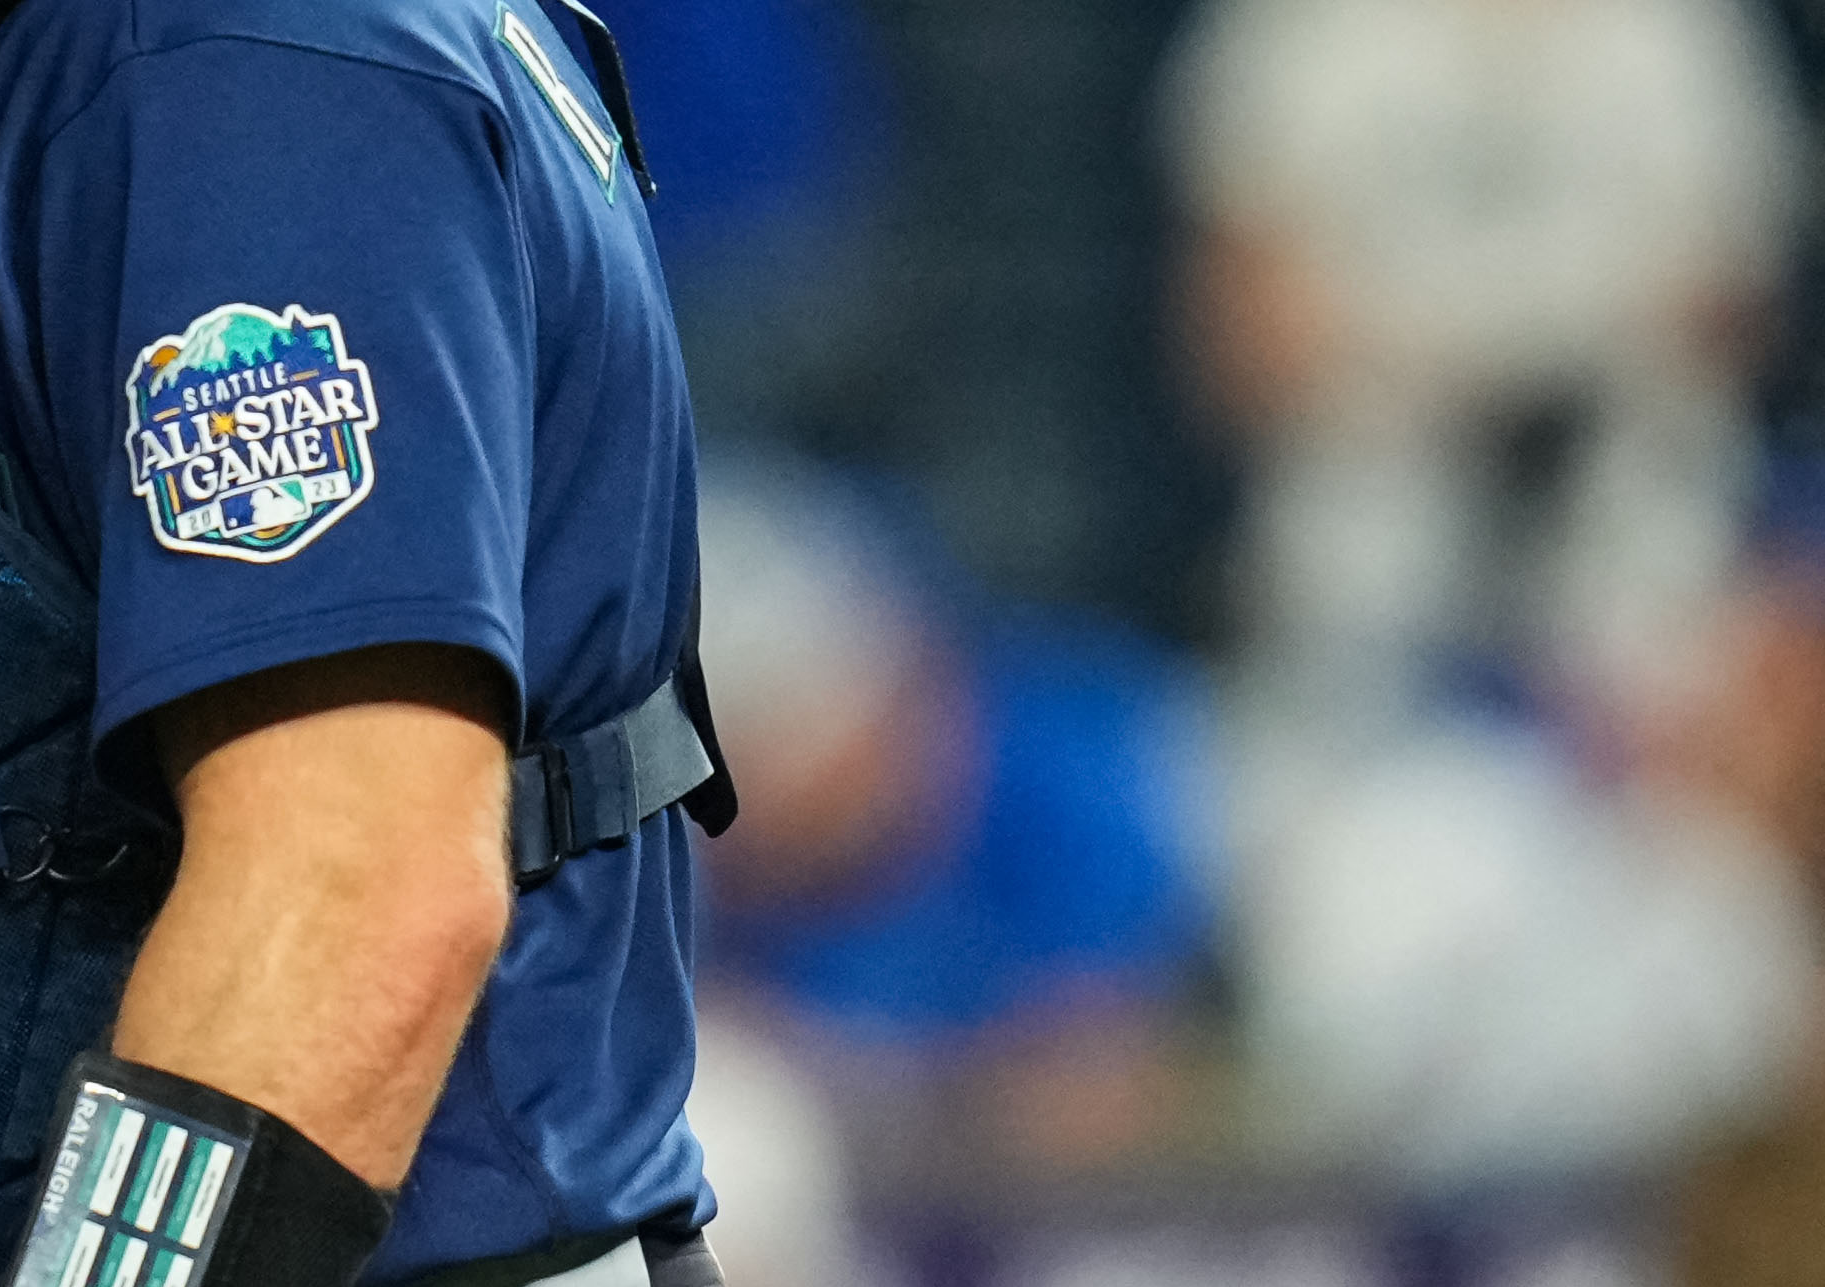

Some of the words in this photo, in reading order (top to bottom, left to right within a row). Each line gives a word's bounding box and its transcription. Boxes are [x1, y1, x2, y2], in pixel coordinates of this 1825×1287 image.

[181, 362, 289, 413] SEATTLE
[138, 412, 230, 481] ALL
[233, 378, 364, 442] STAR
[181, 426, 328, 501] GAME
[187, 508, 212, 532] 20
[39, 1095, 98, 1216] RALEIGH
